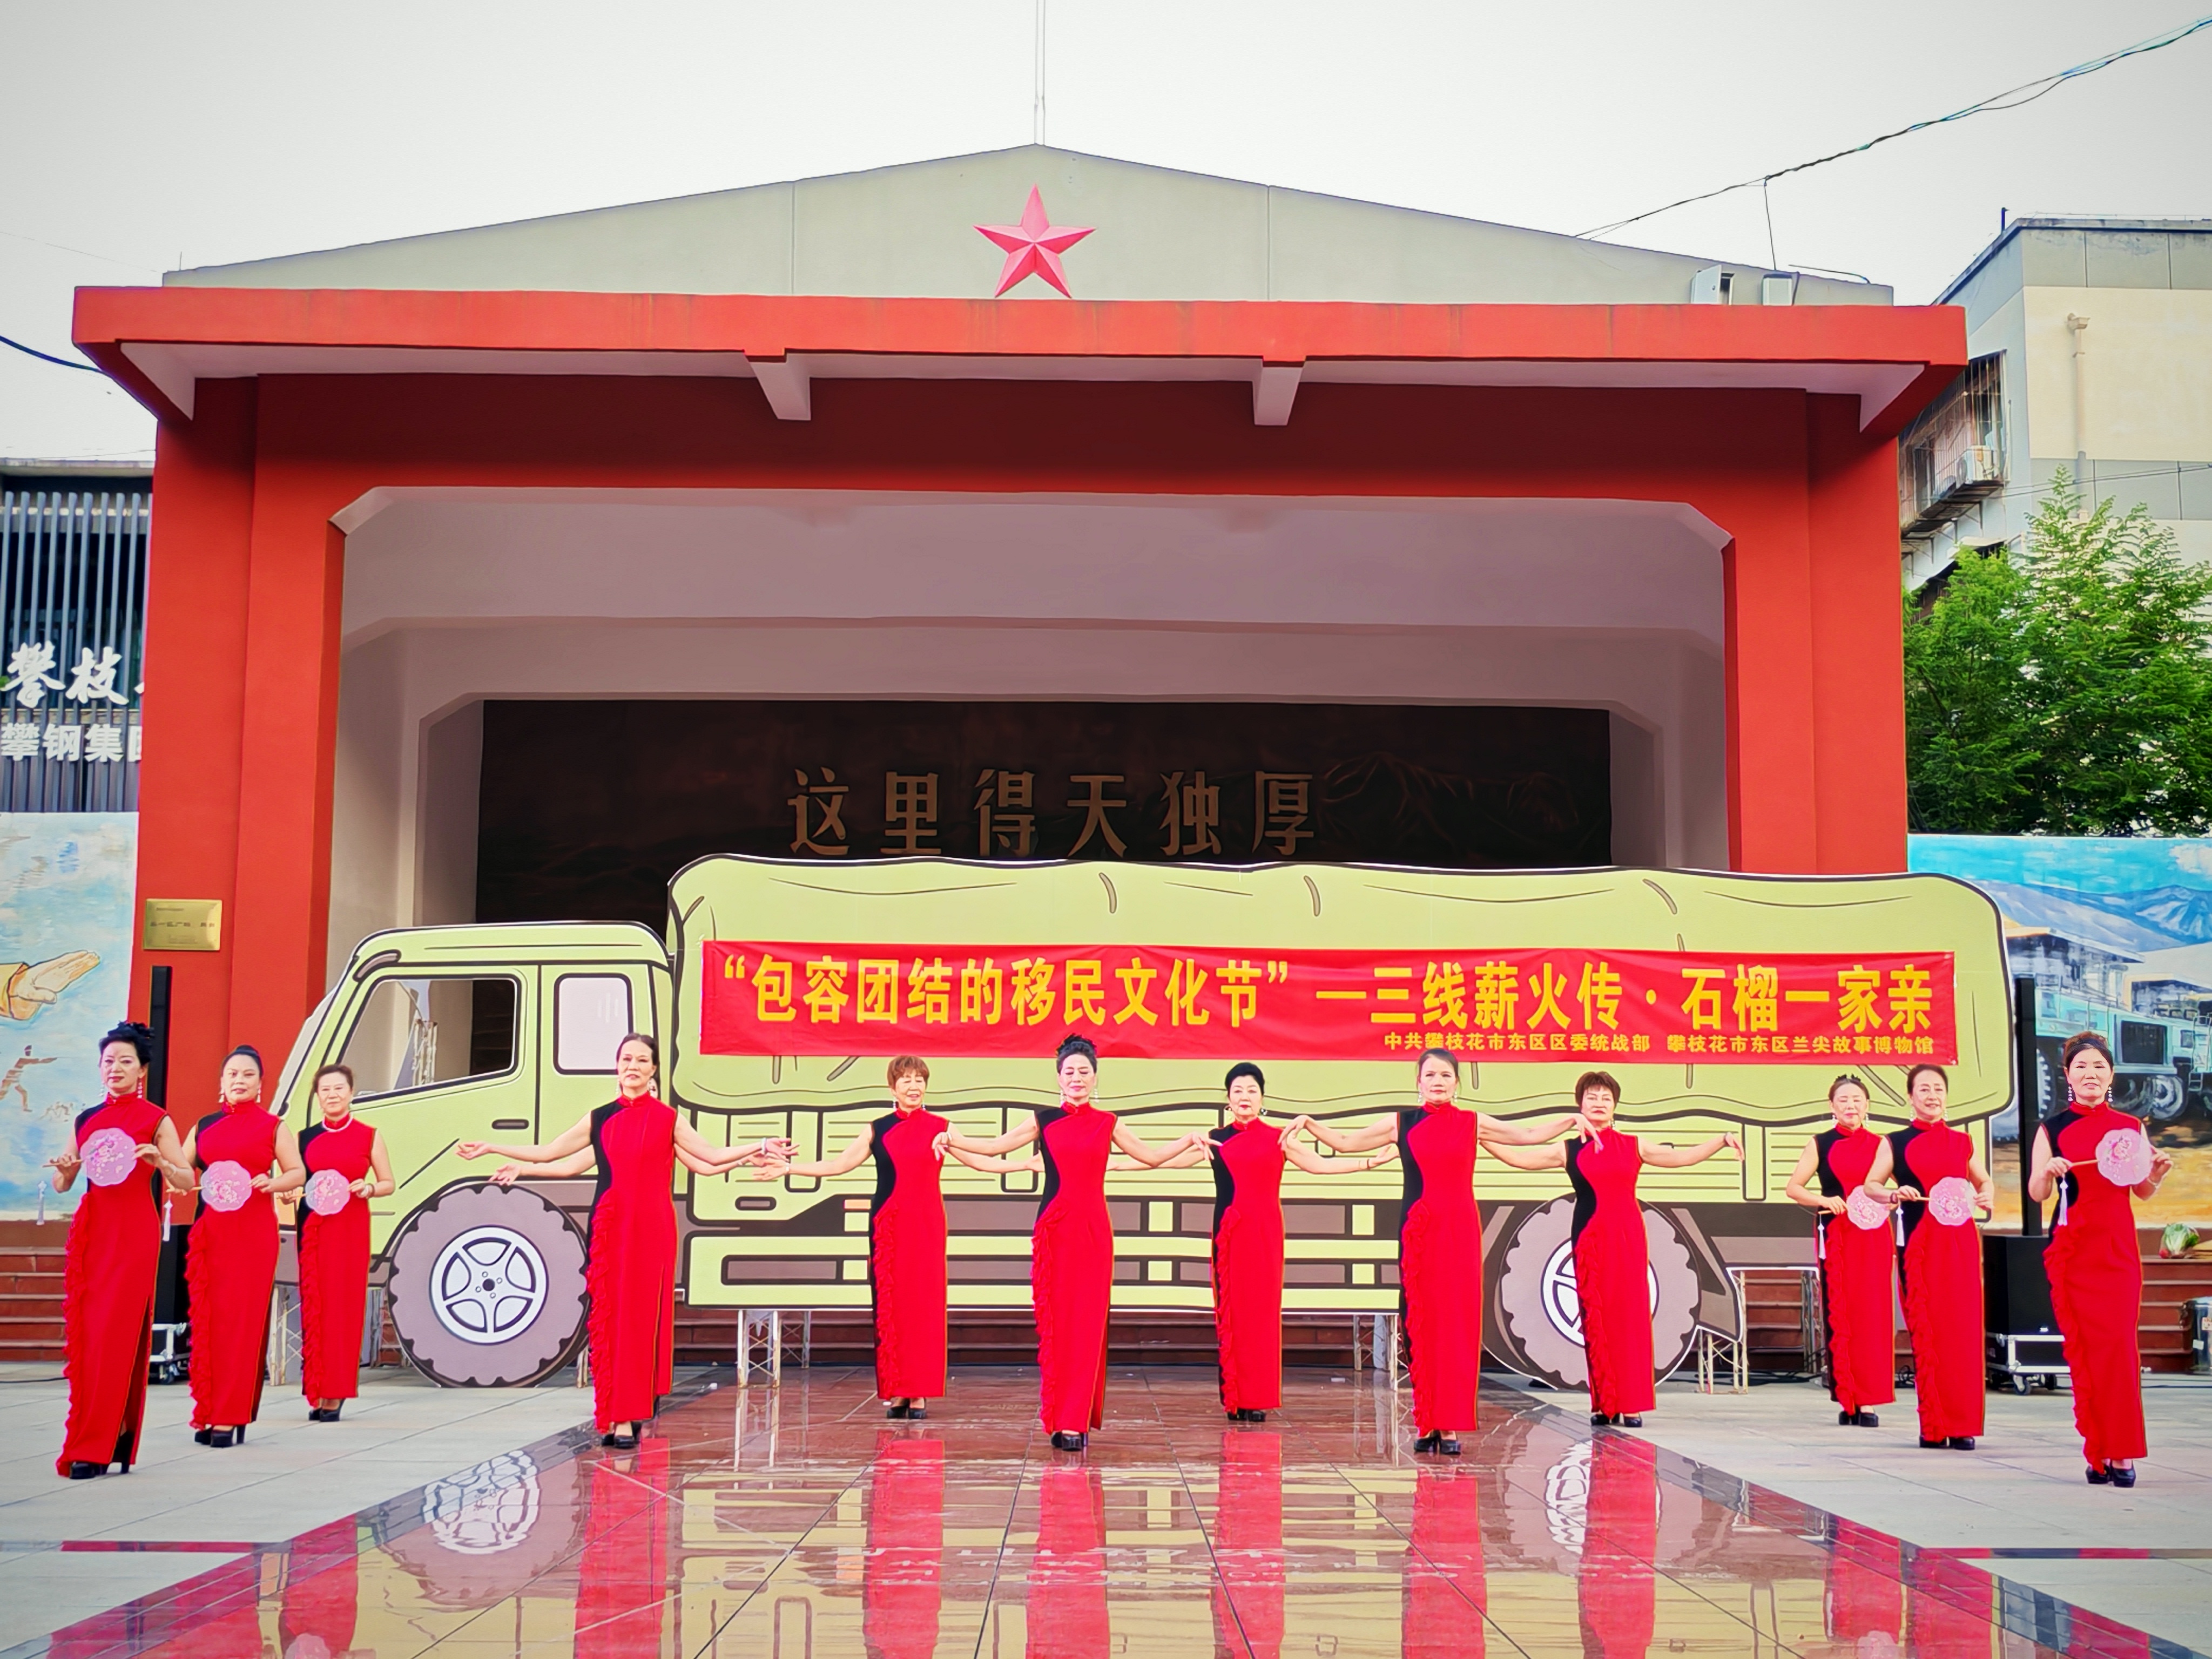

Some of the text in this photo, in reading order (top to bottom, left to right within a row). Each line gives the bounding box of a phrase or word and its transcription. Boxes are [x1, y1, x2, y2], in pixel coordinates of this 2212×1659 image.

[0, 640, 144, 708] 攀枝
[787, 766, 1314, 858] 这里得天独厚
[1384, 1031, 1933, 1054] 中共攀枝花市东区区委统战部 攀枝花市东区兰尖故事博物馆
